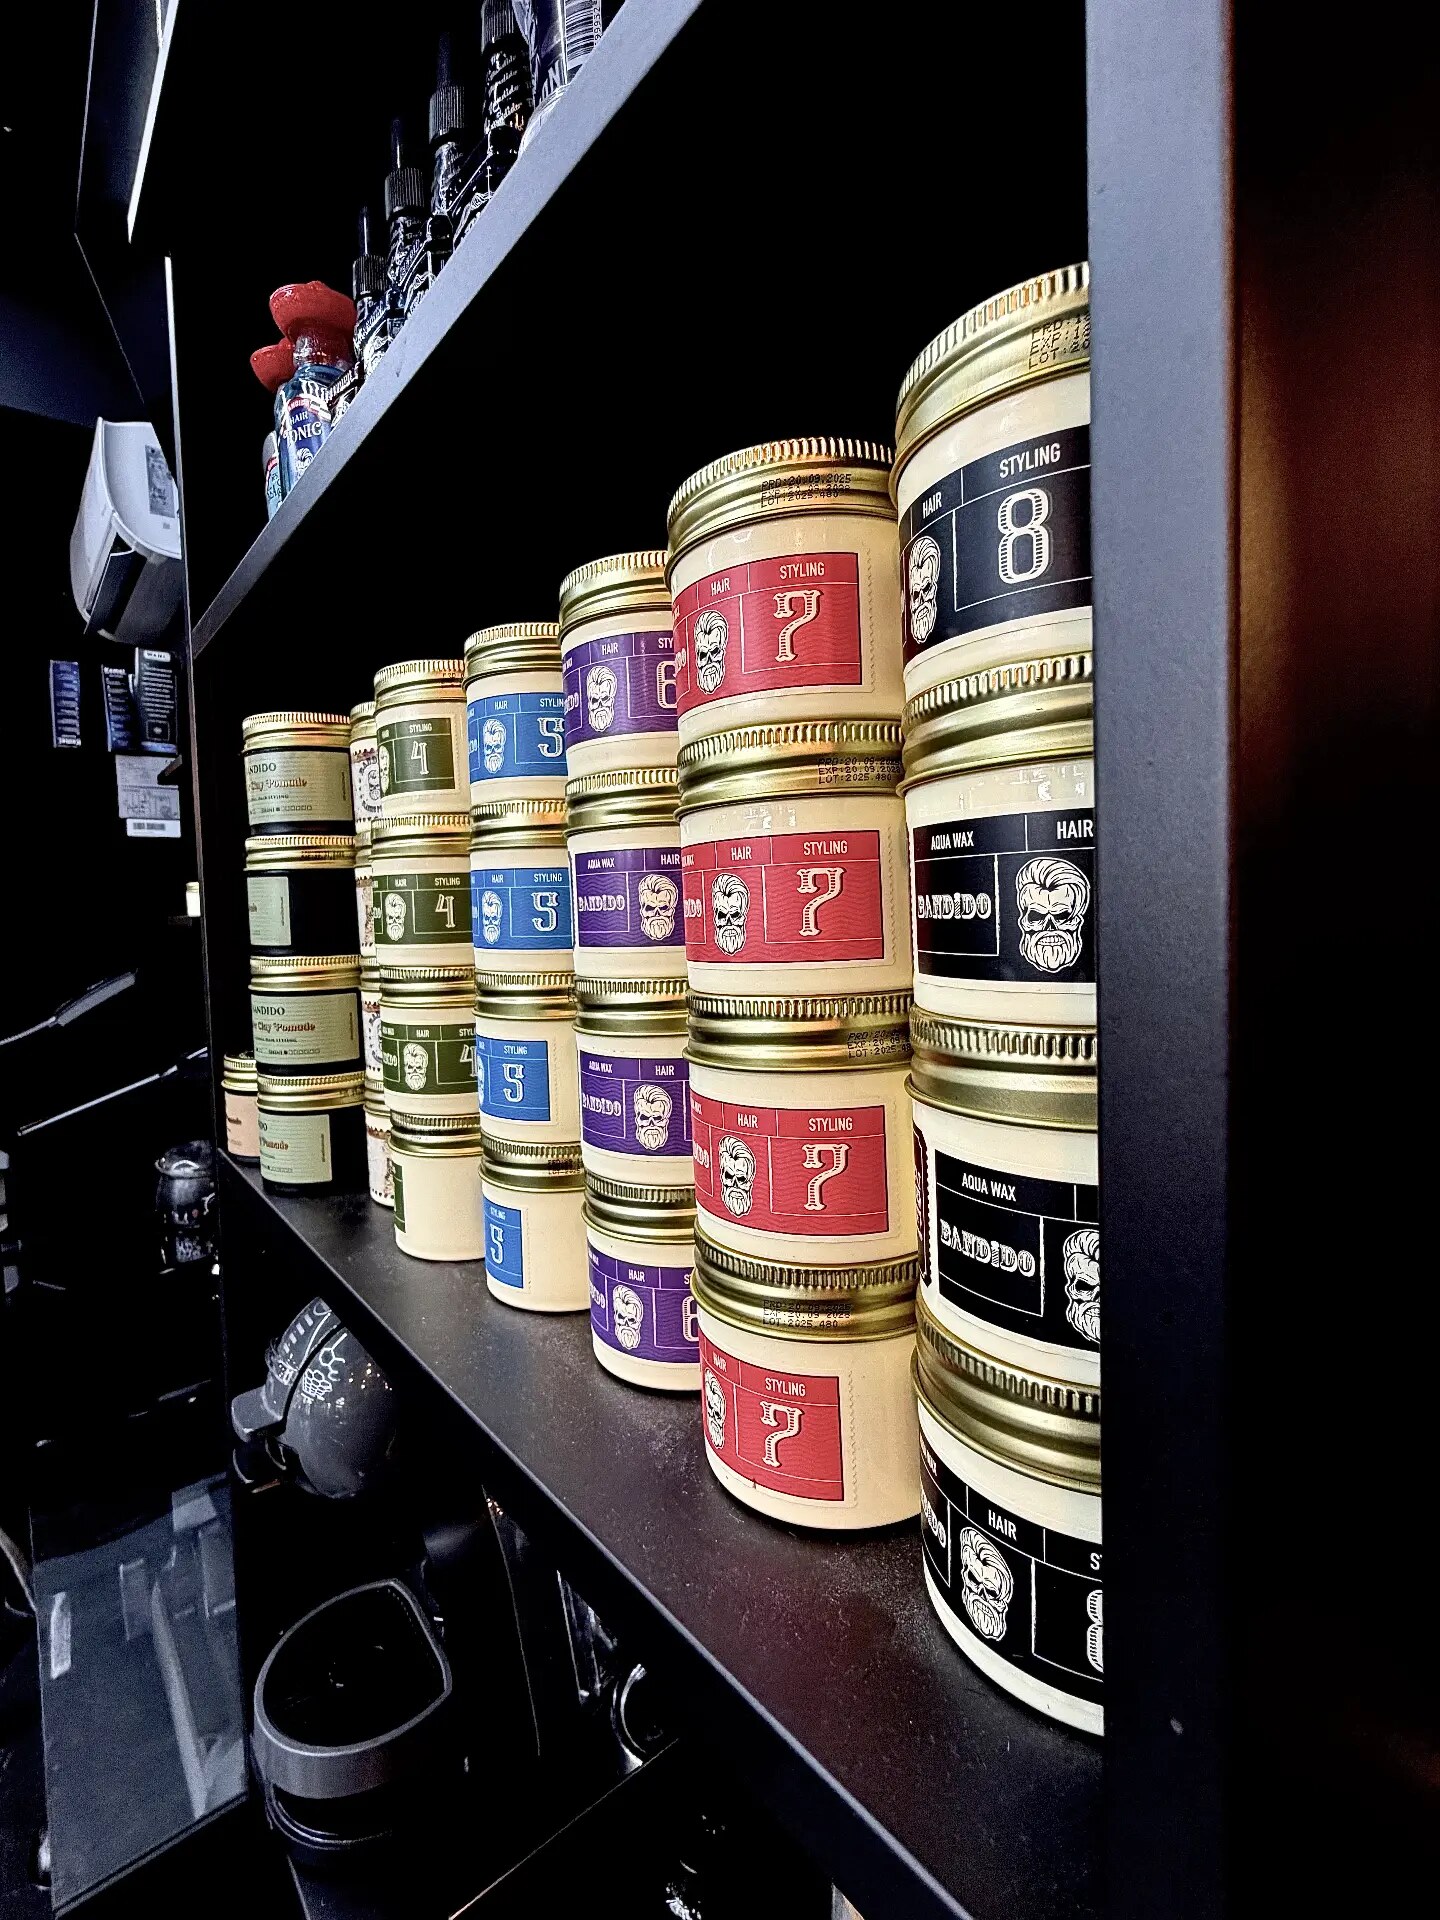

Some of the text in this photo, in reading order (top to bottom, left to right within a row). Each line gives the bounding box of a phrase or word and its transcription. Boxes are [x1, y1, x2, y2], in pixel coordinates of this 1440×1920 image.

[922, 443, 1060, 519] HAIR STYLING
[997, 487, 1053, 585] 8
[711, 562, 825, 596] HAIR STYLING
[773, 589, 824, 662] 7
[601, 642, 619, 656] HAIR
[494, 701, 508, 710] HAIR
[536, 717, 565, 758] 5
[410, 740, 430, 775] 4
[818, 773, 893, 785] LOT:2025.480
[730, 840, 848, 860] HAIR STYLING
[931, 818, 1093, 851] AQUA WAX HAIR
[587, 859, 601, 870] AQUA
[601, 857, 615, 868] WAX
[660, 853, 681, 865] HAIR
[434, 876, 461, 887] STYLING
[533, 873, 563, 884] STYLING
[434, 893, 456, 929] 4
[531, 891, 559, 932] 5
[578, 895, 626, 912] BANDIDO
[796, 866, 847, 938] 7
[917, 892, 991, 920] BANDIDO
[415, 1029, 430, 1038] HAIR
[503, 1045, 528, 1055] STYLING
[502, 1063, 524, 1103] 5
[655, 1065, 675, 1076] HAIR
[582, 1092, 622, 1117] BANDIDO
[737, 1113, 853, 1132] HAIR STYLING
[801, 1143, 853, 1211] 7
[961, 1172, 1016, 1202] AQUA WAX
[489, 1222, 504, 1265] 5
[940, 1218, 1036, 1278] BANDIDO
[628, 1269, 646, 1283] HAIR
[762, 1317, 839, 1329] LOT:2025.480
[713, 1351, 806, 1398] HAIR STYLING
[760, 1400, 805, 1468] 7
[988, 1509, 1017, 1541] HAIR
